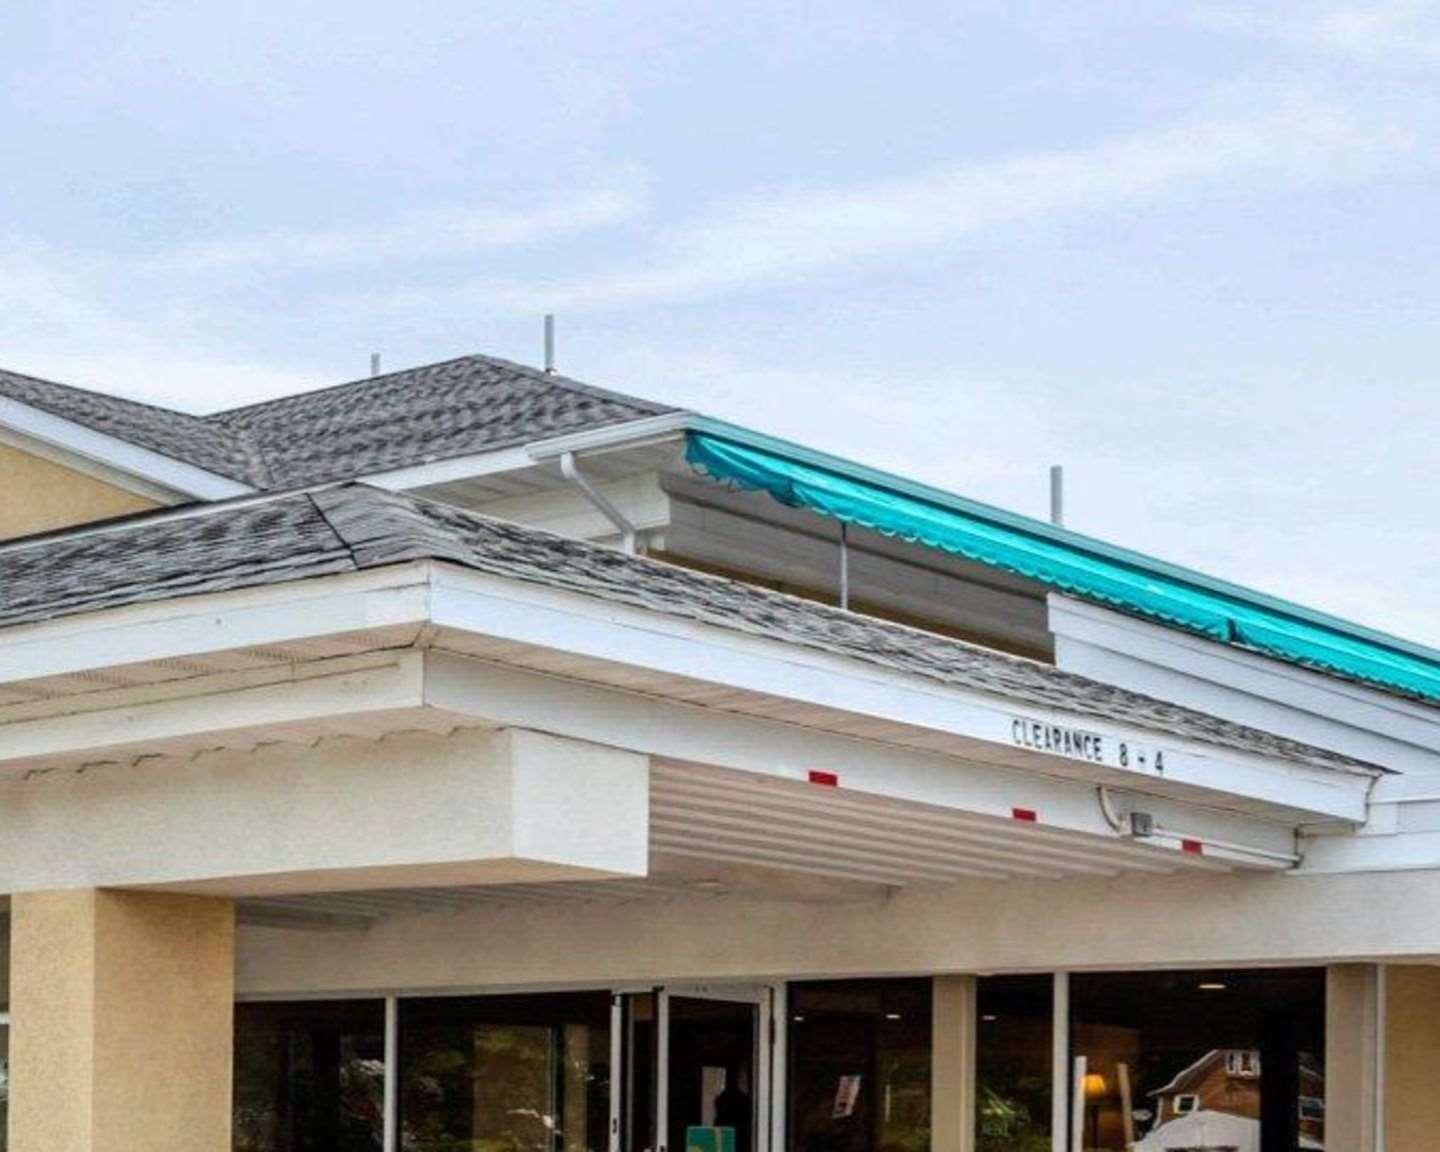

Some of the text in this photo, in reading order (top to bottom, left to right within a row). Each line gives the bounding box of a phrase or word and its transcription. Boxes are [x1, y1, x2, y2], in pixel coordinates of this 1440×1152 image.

[1012, 718, 1103, 761] CLEARANCE
[1119, 742, 1129, 767] 8
[1155, 750, 1165, 774] 4
